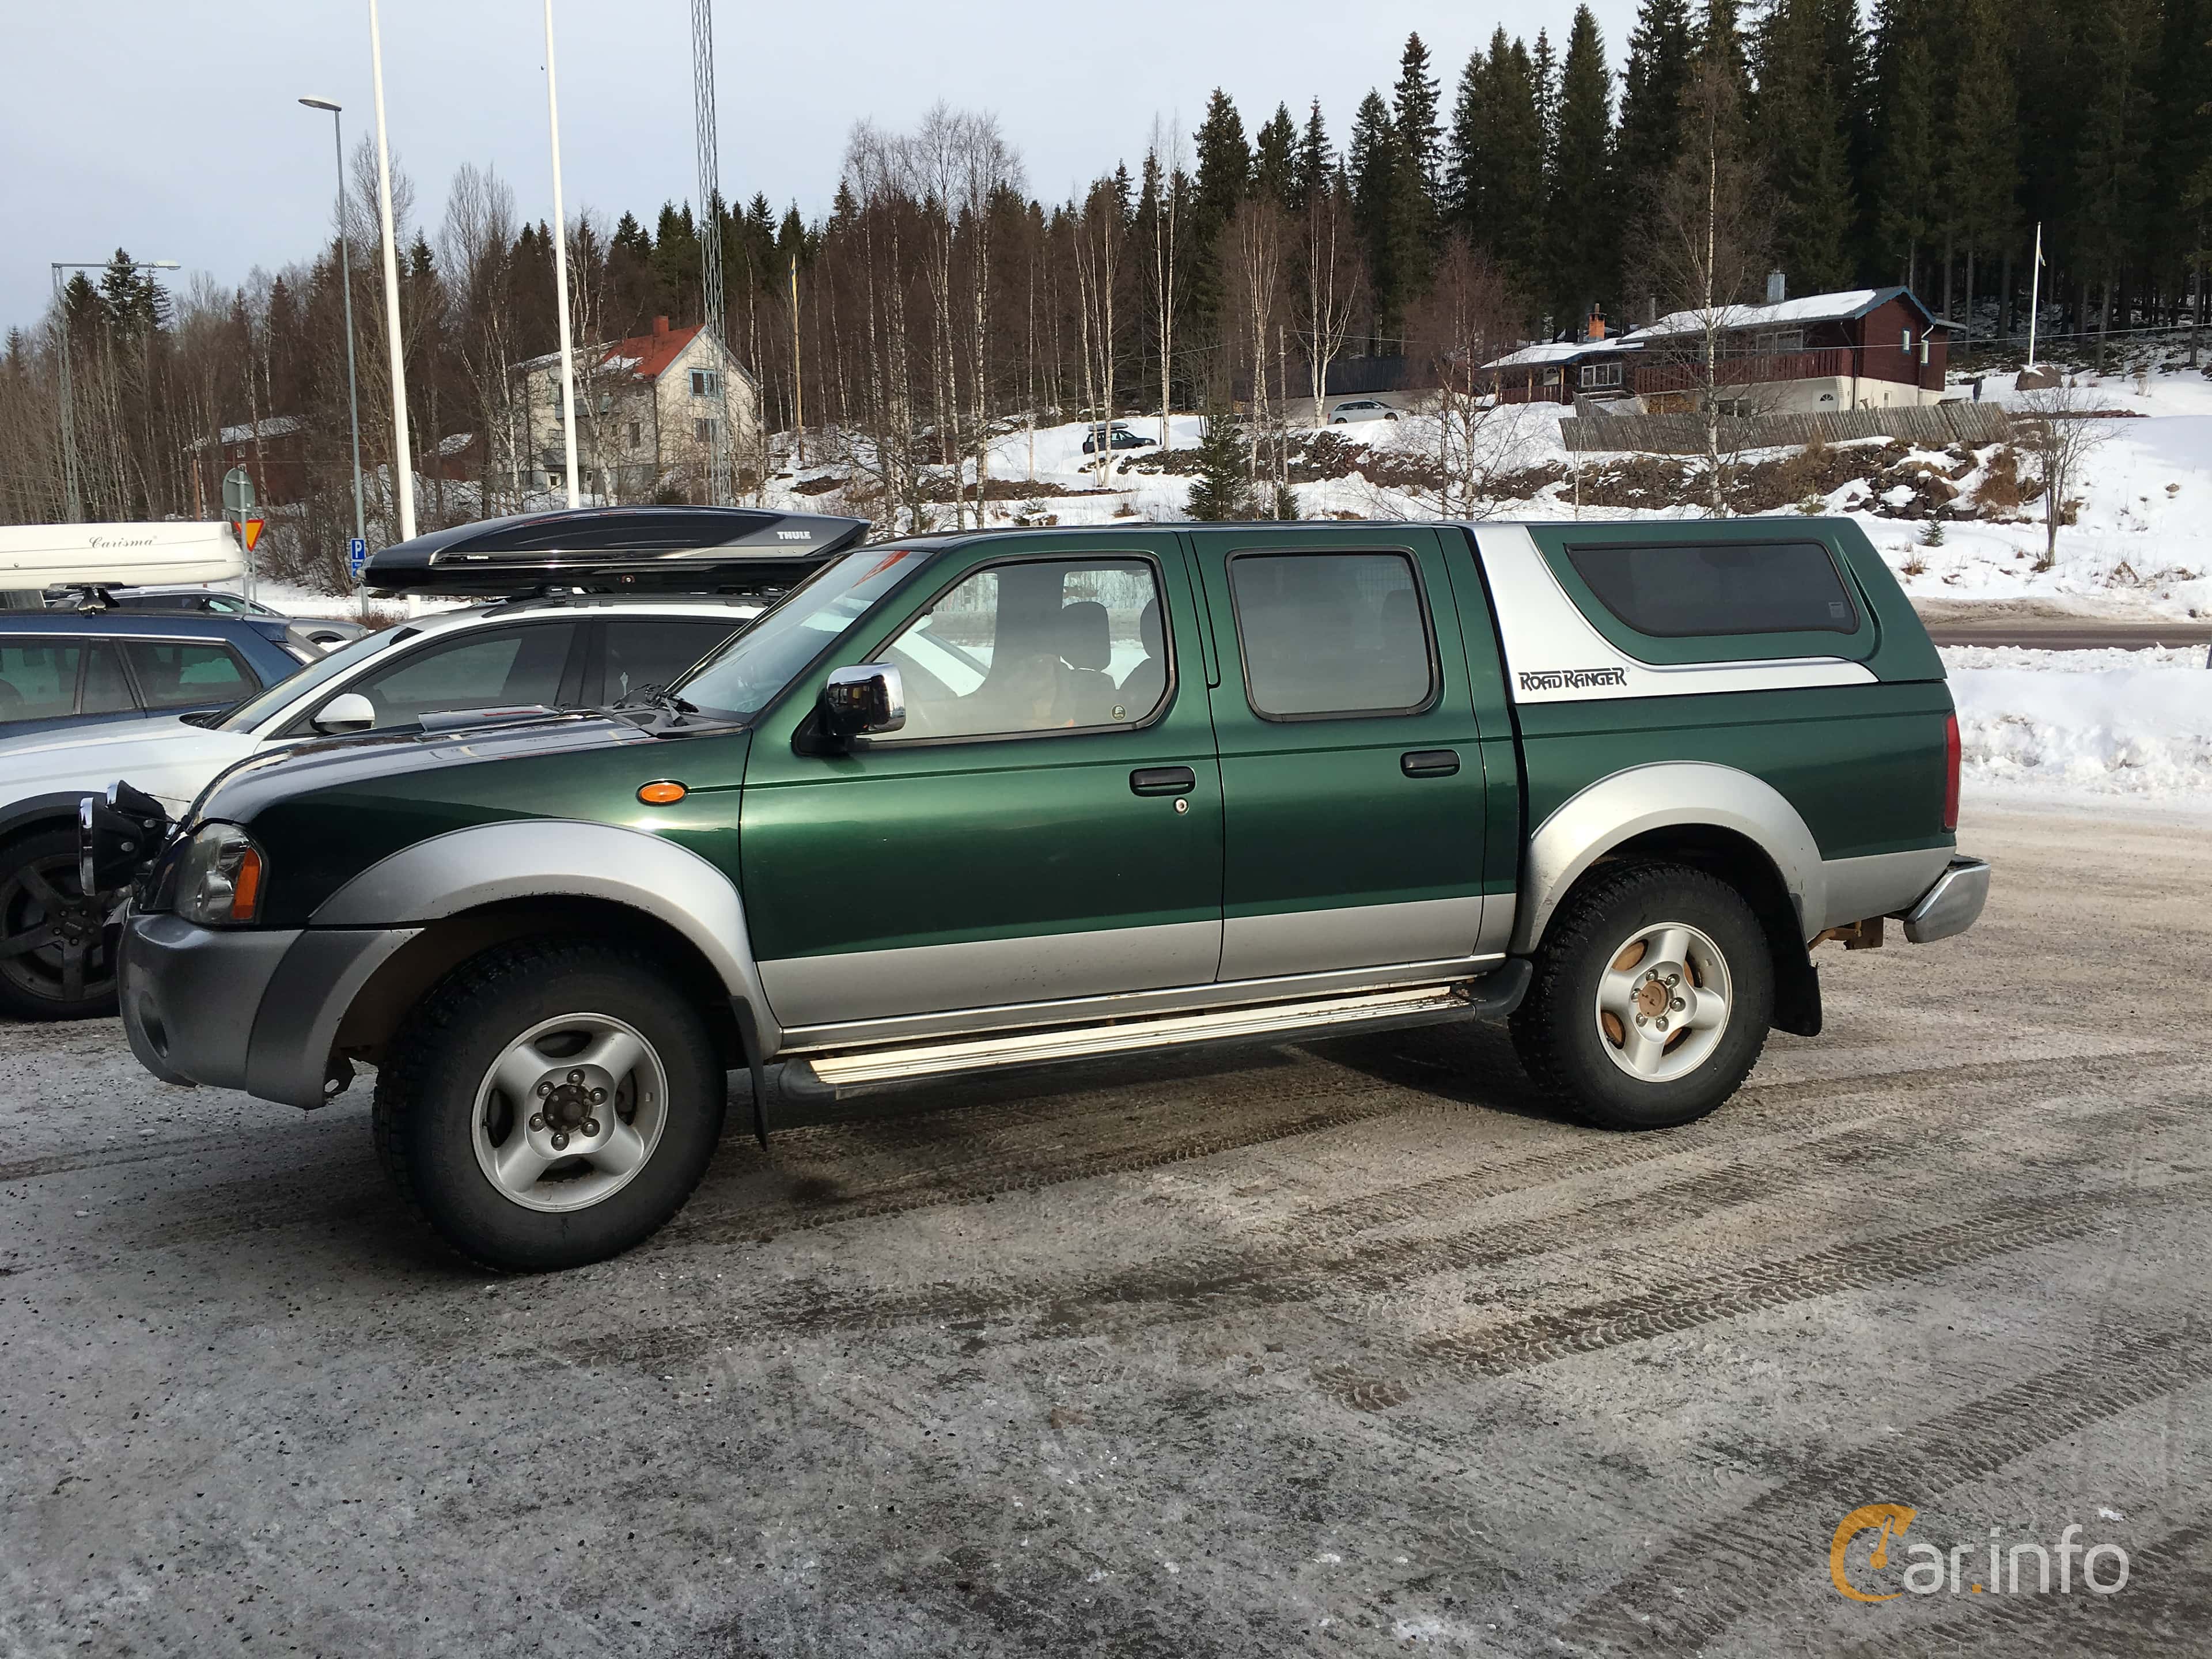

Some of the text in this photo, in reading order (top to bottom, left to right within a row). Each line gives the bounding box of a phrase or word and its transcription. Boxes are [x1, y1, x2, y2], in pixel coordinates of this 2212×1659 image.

[89, 536, 153, 549] Carisma
[777, 531, 812, 540] THULE
[355, 541, 362, 558] P
[1518, 667, 1627, 691] ROAD RANGER
